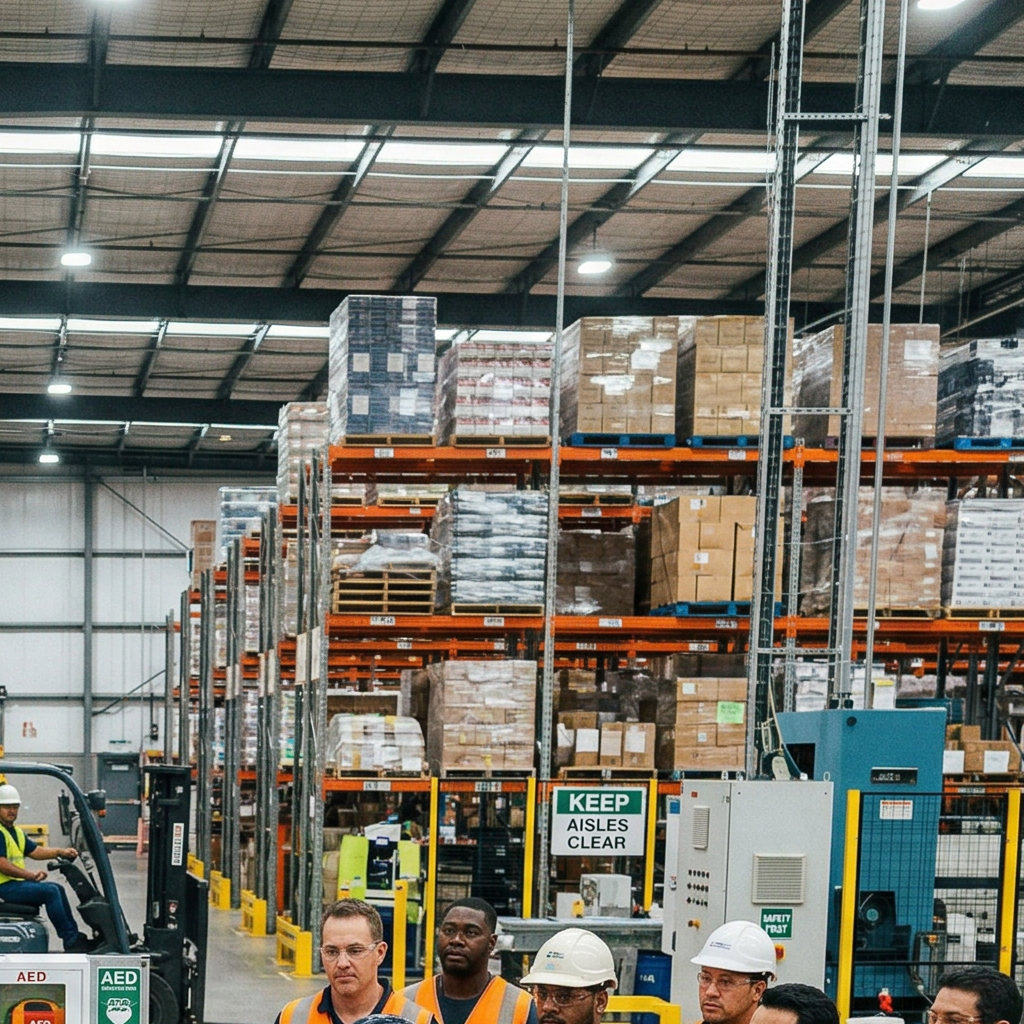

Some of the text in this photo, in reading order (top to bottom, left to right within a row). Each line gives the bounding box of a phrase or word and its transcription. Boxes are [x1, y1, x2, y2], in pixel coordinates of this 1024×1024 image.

[569, 793, 630, 812] KEEP
[567, 818, 629, 832] AISLES
[567, 836, 626, 849] CLEAR
[16, 971, 47, 982] AED
[100, 971, 138, 985] AED
